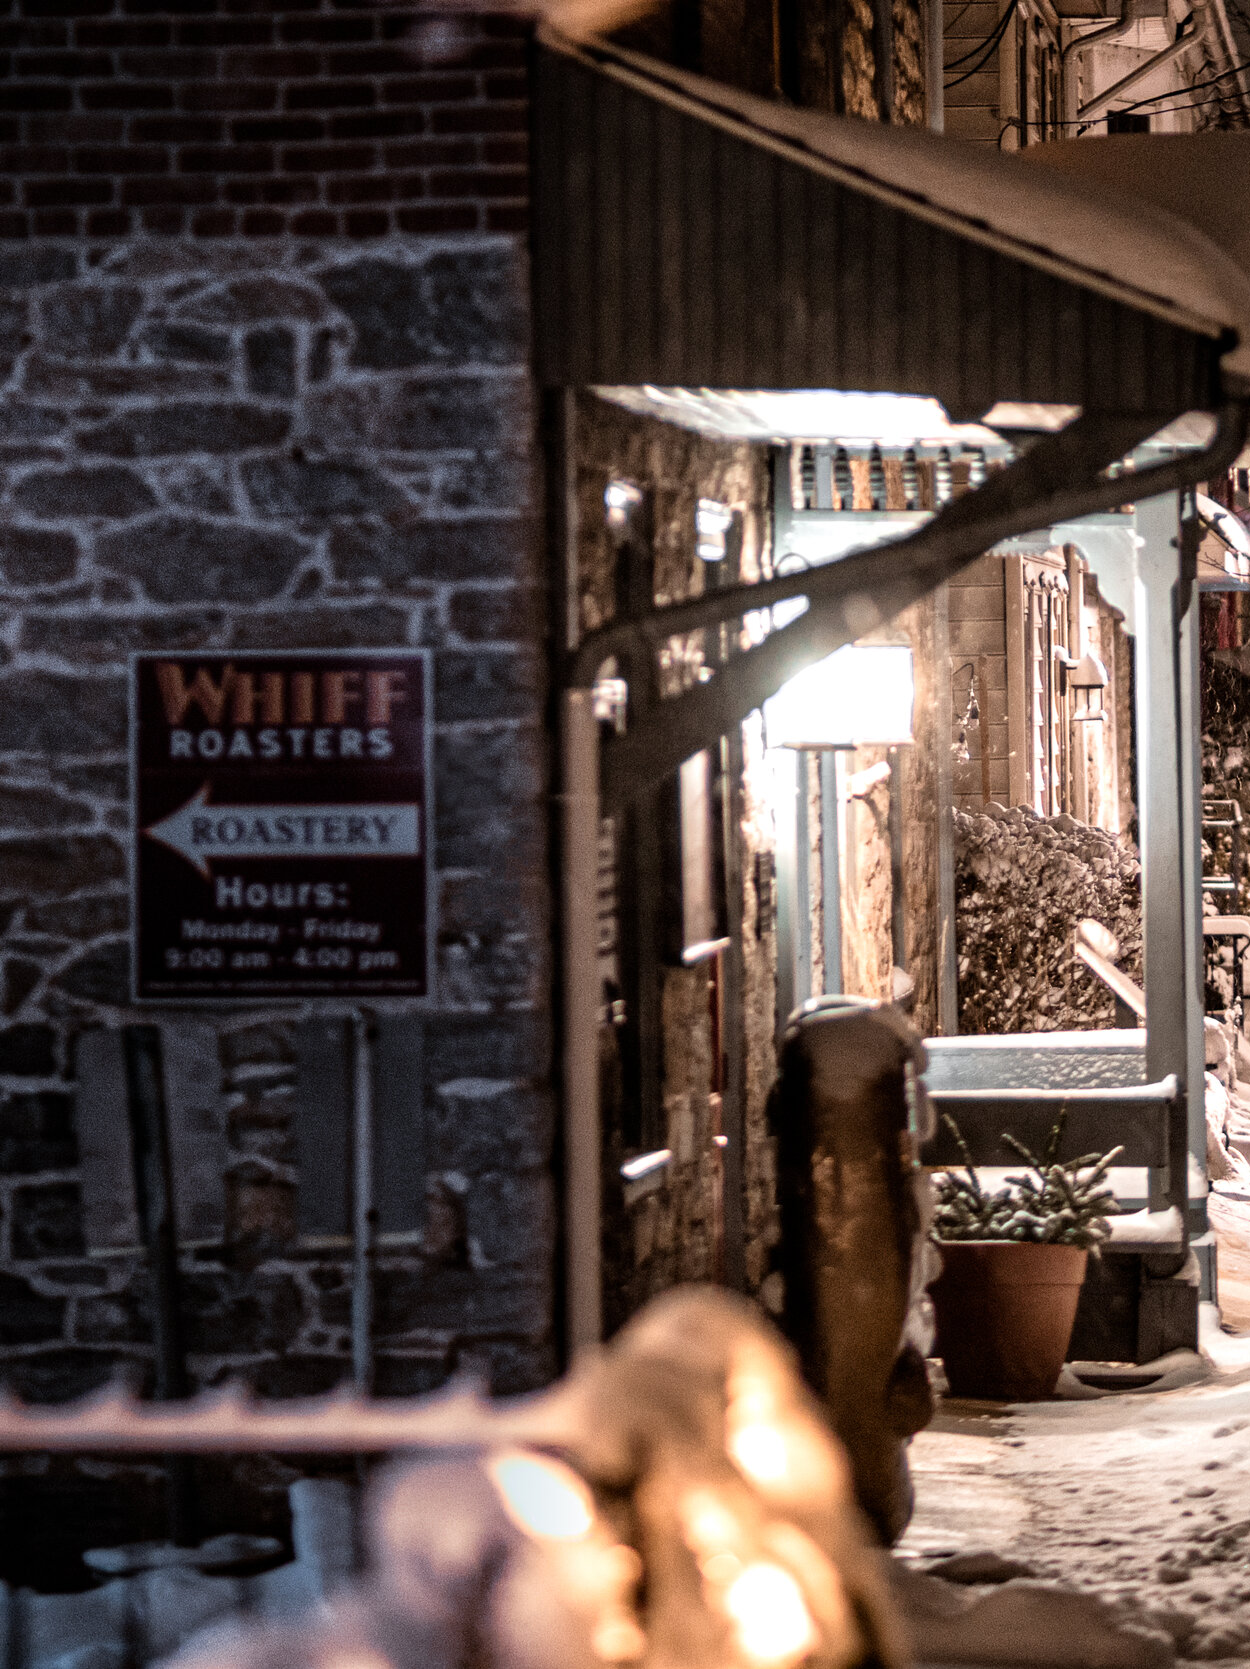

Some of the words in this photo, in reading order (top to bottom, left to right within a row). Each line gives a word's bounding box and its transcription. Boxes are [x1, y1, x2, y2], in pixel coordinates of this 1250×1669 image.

[156, 662, 405, 725] WHIFF
[169, 727, 394, 759] ROASTERS
[190, 814, 397, 846] ROASTERY
[214, 875, 349, 907] Hours:
[181, 919, 281, 943] Monday
[302, 918, 381, 943] Friday
[230, 951, 272, 968] am
[292, 948, 352, 968] 4:00
[358, 951, 399, 972] pm
